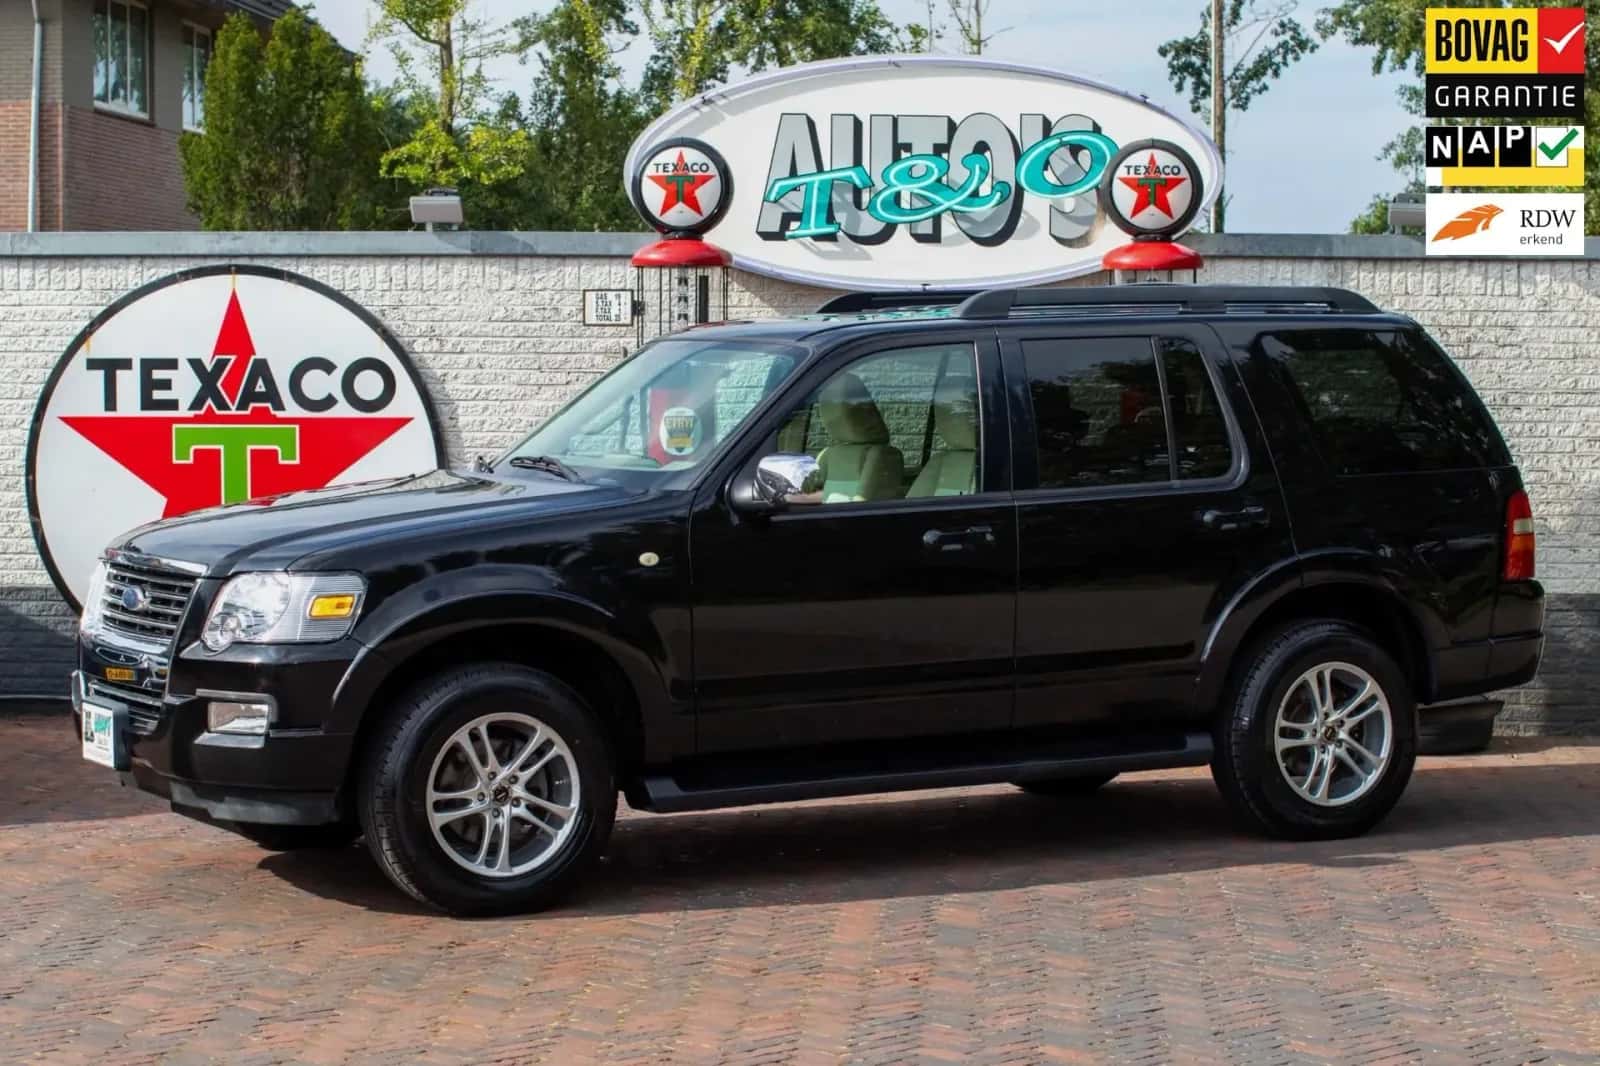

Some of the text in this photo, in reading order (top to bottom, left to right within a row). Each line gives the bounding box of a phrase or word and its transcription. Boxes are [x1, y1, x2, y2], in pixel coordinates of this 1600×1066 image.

[653, 161, 710, 174] TEXACO
[1124, 164, 1181, 176] TEXACO
[86, 356, 397, 413] TEXACO
